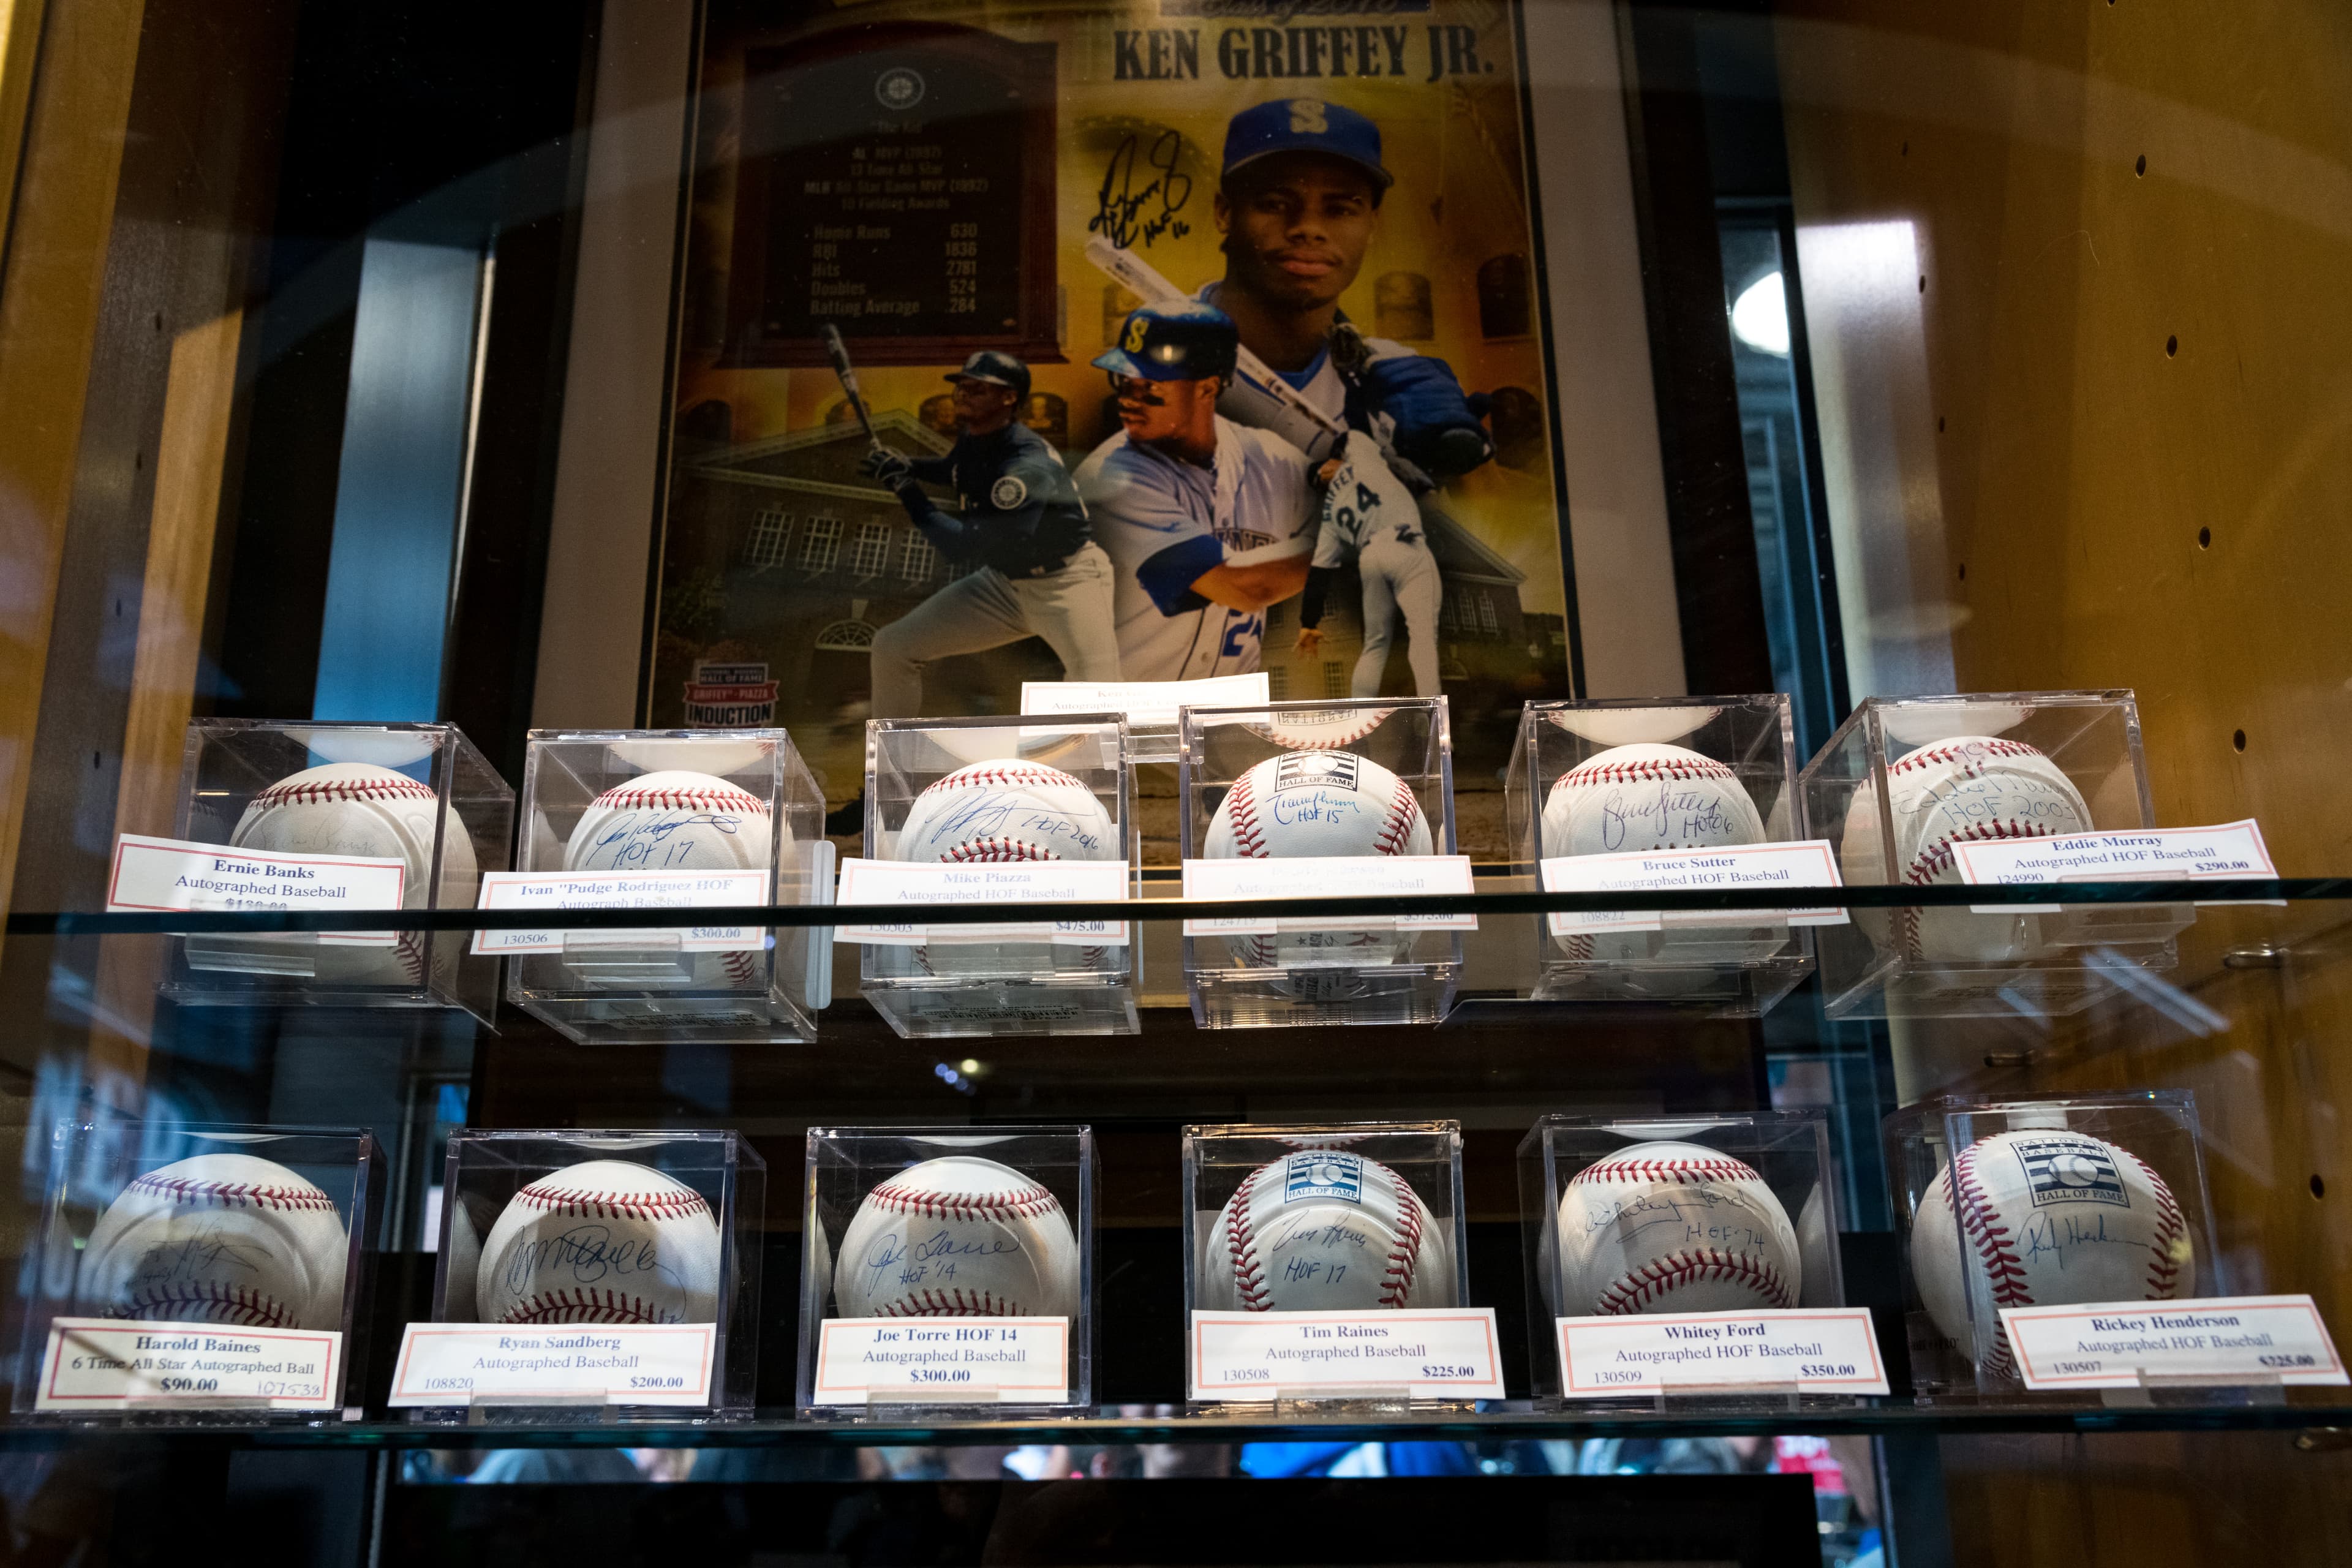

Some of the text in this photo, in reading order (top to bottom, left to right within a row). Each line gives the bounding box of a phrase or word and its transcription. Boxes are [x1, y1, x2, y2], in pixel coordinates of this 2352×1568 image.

[1113, 24, 1494, 83] KEN GRIFFEY JR.
[815, 223, 978, 239] Home Runs 630
[945, 241, 978, 257] 1836
[812, 262, 841, 277] Hits
[811, 278, 976, 296] Doubles 524
[810, 299, 862, 317] Batting
[865, 298, 920, 317] Average
[1336, 481, 1382, 539] 24
[1098, 690, 1123, 699] Ken
[688, 703, 772, 724] INDUCTION
[1280, 777, 1306, 788] HALL
[1326, 777, 1354, 788] FAME
[1327, 810, 1344, 824] 15
[1942, 797, 2001, 825] HOF
[2052, 835, 2163, 852] Eddie Murray
[665, 840, 695, 867] 17
[2015, 846, 2217, 870] Autographed HOF Baseball
[213, 859, 315, 879] Ernie Banks
[1642, 857, 1736, 871] Bruce Sutter
[1997, 860, 2250, 884] 124990 $290.00
[943, 872, 1031, 884] Mike Piazza
[1598, 869, 1790, 891] Autographed HOF Baseball
[175, 875, 346, 899] Autographed Baseball
[521, 886, 553, 896] Ivan
[617, 880, 692, 894] Rodriguez
[696, 879, 733, 891] HOF
[897, 888, 1076, 902] Autographed HOF Baseball
[557, 896, 692, 908] Autograph Baseball
[503, 933, 548, 945] 130506
[691, 927, 741, 940] $300.00
[2016, 1137, 2101, 1148] NATIONAL
[2022, 1148, 2108, 1158] BASEBALL
[1289, 1188, 1314, 1199] HALL
[1332, 1188, 1357, 1199] FAME
[2036, 1189, 2125, 1203] HALL OF FAME
[899, 1266, 927, 1285] HOF
[1284, 1256, 1346, 1284] HOF 17
[1300, 1324, 1389, 1339] Tim Raines
[1664, 1322, 1766, 1341] Whitey Ford
[2090, 1314, 2241, 1333] Rickey Henderson
[498, 1335, 622, 1351] Ryan Sandberg
[873, 1328, 1018, 1343] Joe Torre HOF 14
[2076, 1333, 2274, 1355] Autographed HOF Baseball
[135, 1336, 261, 1354] Harold Baines
[1265, 1344, 1427, 1362] Autographed Baseball
[1615, 1342, 1823, 1365] Autographed HOF Baseball
[473, 1355, 639, 1372] Autographed Baseball
[862, 1349, 1027, 1365] Autographed Baseball
[72, 1357, 315, 1375] 6 Time All Star Autographed Ball
[1223, 1365, 1475, 1382] 130508 $225.00
[1593, 1363, 1856, 1384] 130509 $350.00
[2053, 1360, 2103, 1374] 130507
[424, 1376, 684, 1390] 108820 $200.00
[910, 1369, 971, 1384] $300.00
[160, 1378, 218, 1393] $90.00
